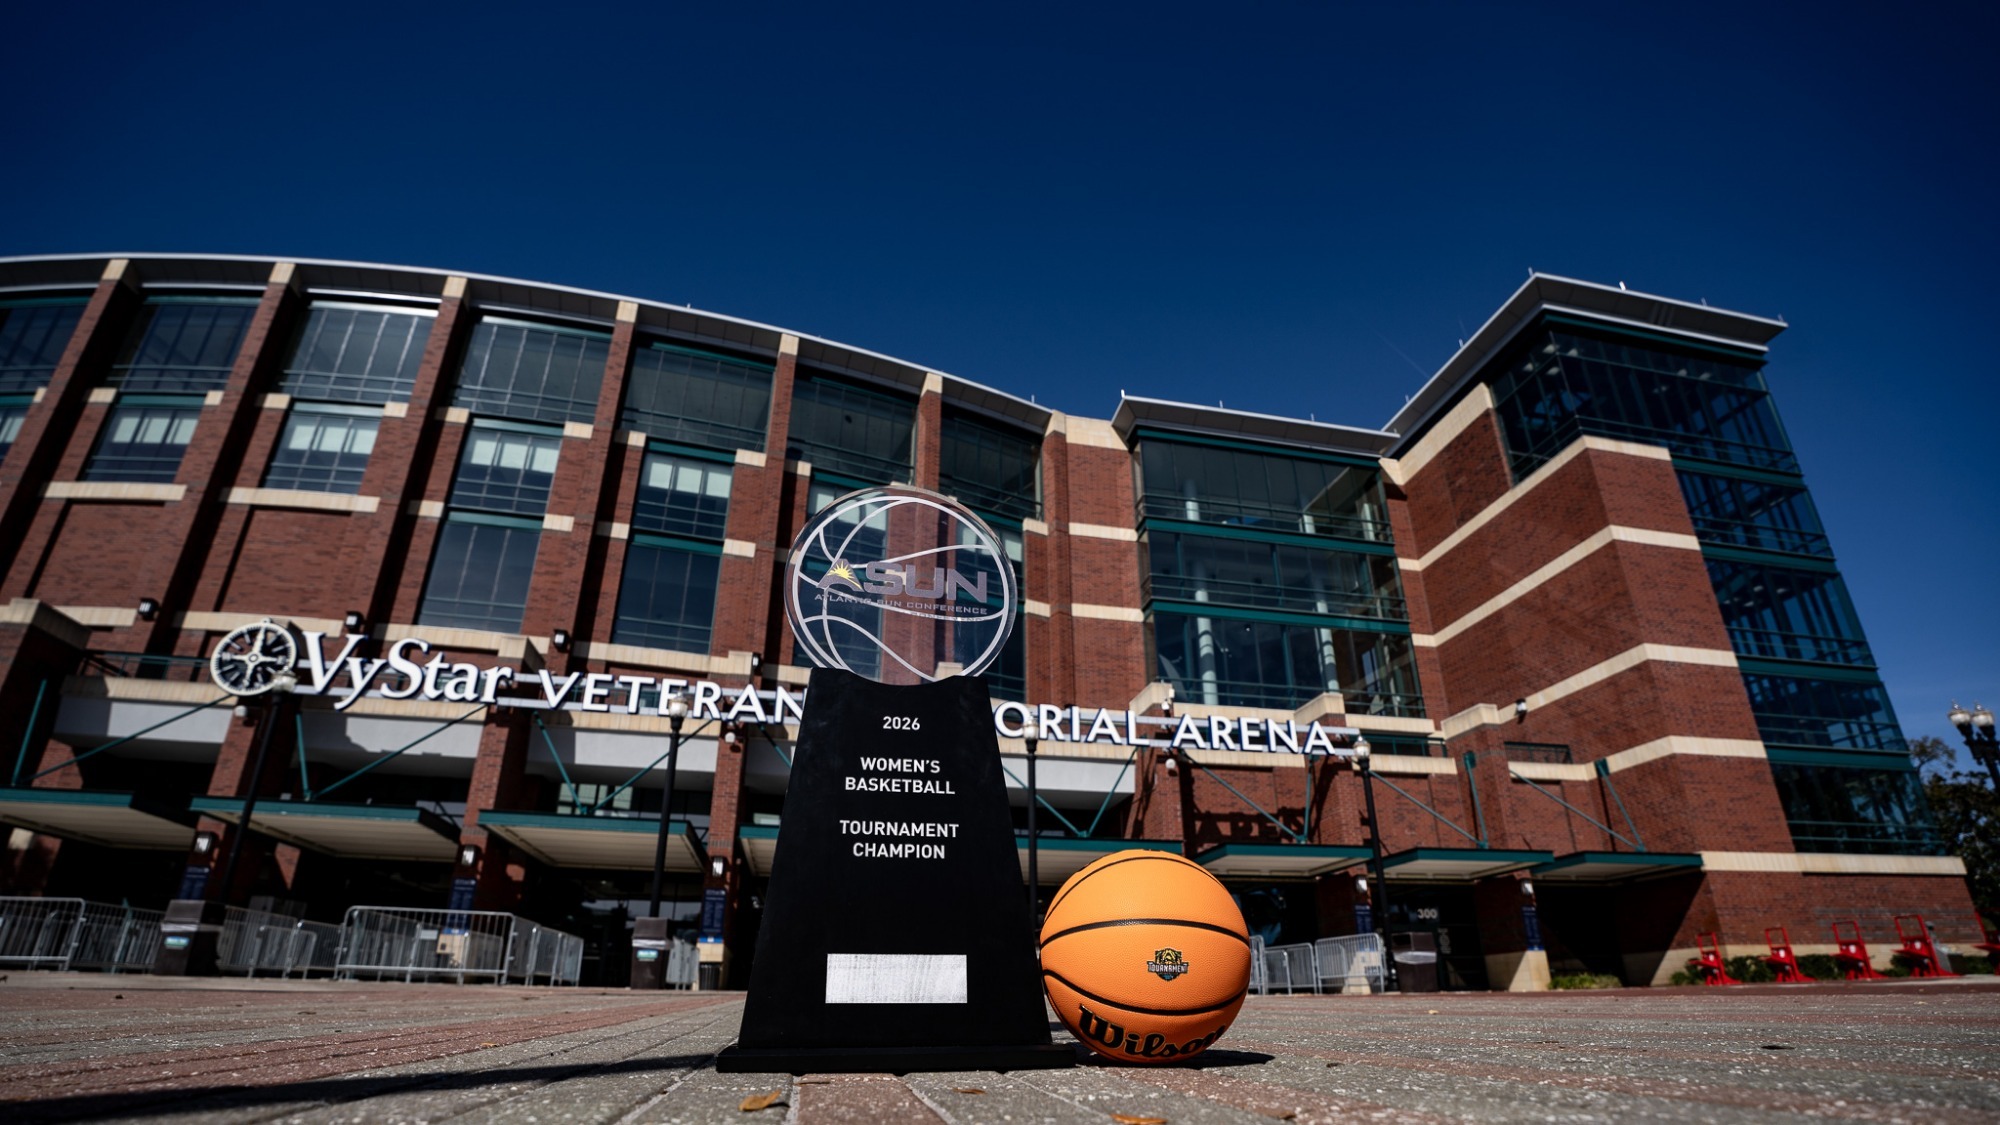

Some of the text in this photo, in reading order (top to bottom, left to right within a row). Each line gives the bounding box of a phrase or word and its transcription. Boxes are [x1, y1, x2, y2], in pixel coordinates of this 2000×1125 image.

[906, 601, 988, 616] CONFERENCE
[303, 631, 1335, 755] VyStar VETERAN ORIAL ARENA
[882, 716, 921, 731] 2026
[860, 756, 941, 774] WOMEN'S
[844, 776, 956, 795] BASKETBALL
[839, 819, 960, 838] TOURNAMENT
[852, 842, 946, 860] CHAMPION
[1416, 907, 1438, 920] 300
[1148, 961, 1187, 973] TOURNAMENT
